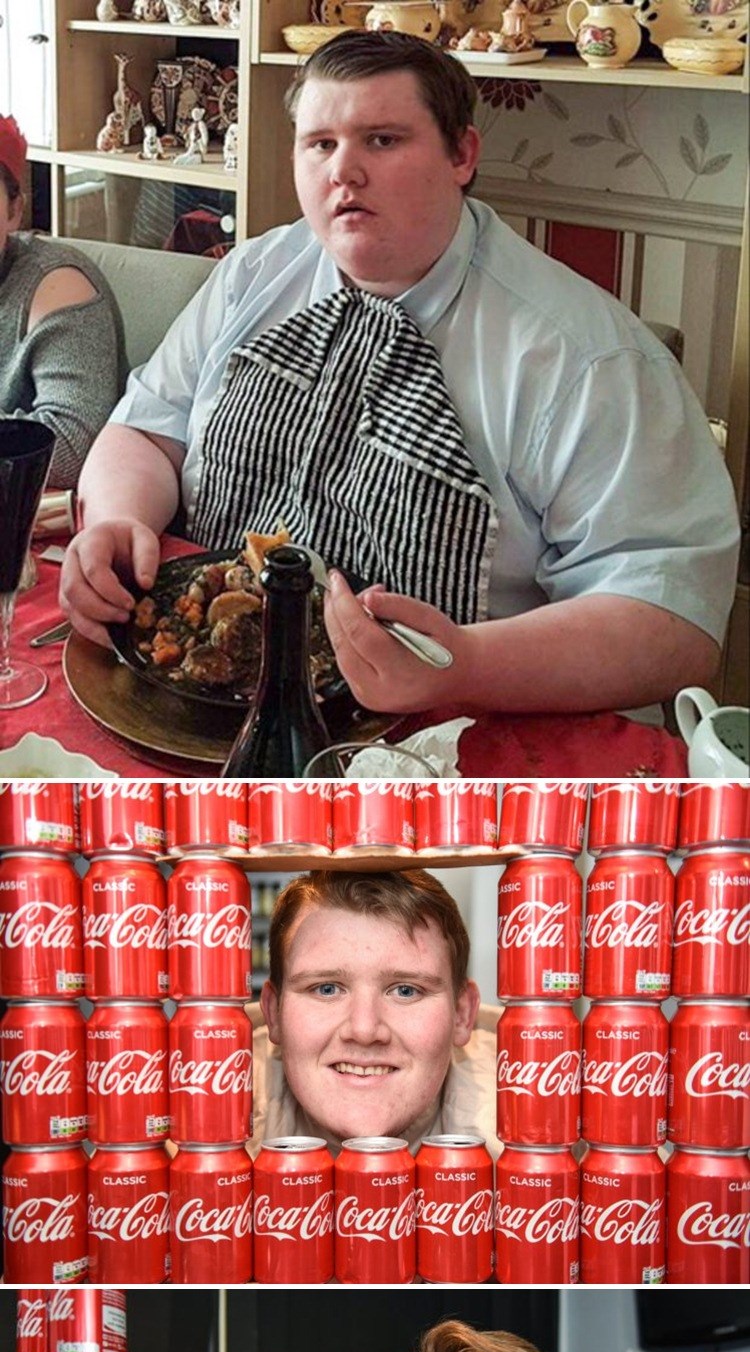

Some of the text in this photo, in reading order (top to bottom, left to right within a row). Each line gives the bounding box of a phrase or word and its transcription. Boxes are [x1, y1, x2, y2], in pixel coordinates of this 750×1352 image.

[0, 881, 27, 890] ASSIC
[709, 876, 750, 886] CLASSI
[93, 882, 136, 892] CLASSIC
[185, 882, 229, 892] CLASSIC
[498, 882, 521, 894] ASSIC
[0, 1030, 24, 1039] ASSIC
[193, 1030, 237, 1039] CLASSIC
[520, 1031, 564, 1039] CLASSIC
[596, 1030, 640, 1040] CLASSIC
[169, 1049, 252, 1096] Coca-Col
[497, 1050, 581, 1097] Coca-Col
[103, 1176, 147, 1186] CLASSIC
[282, 1175, 323, 1186] CLASSIC
[371, 1175, 409, 1187] CLASSIC
[435, 1173, 476, 1182] CLASSIC
[510, 1176, 552, 1187] CLASSIC
[583, 1173, 620, 1187] CLASSIC
